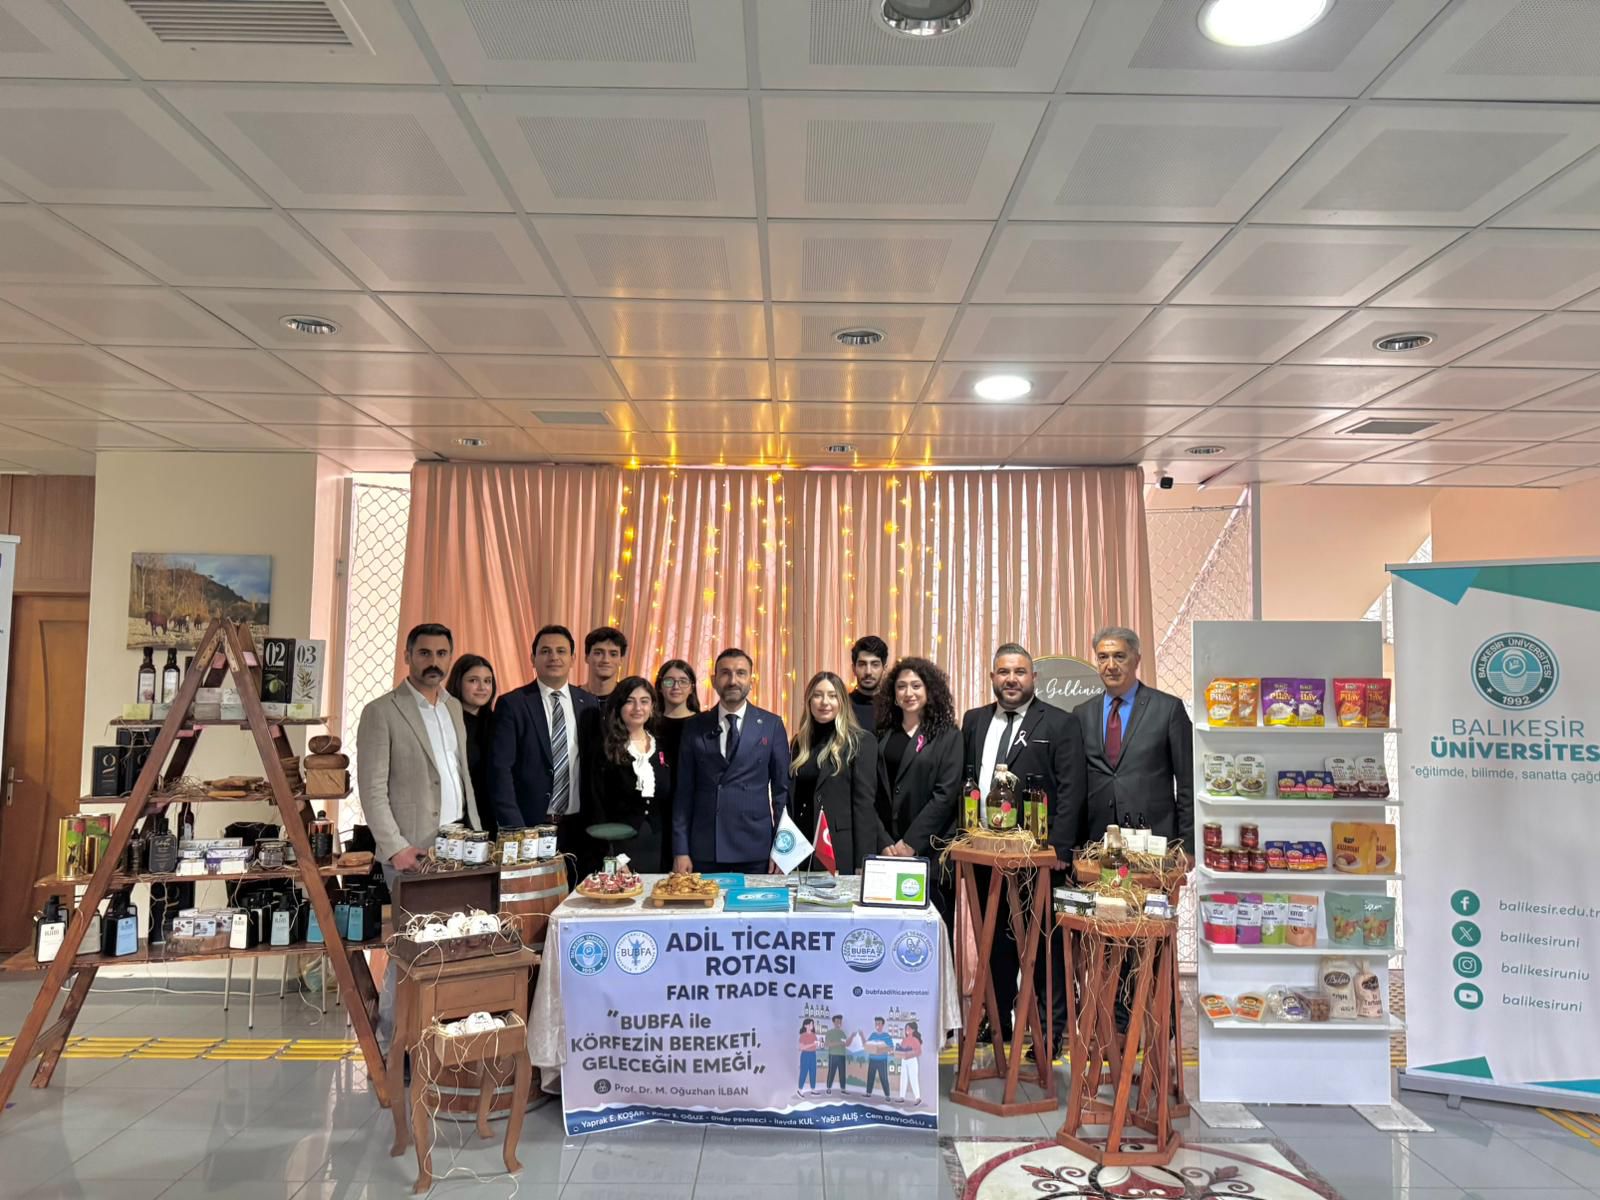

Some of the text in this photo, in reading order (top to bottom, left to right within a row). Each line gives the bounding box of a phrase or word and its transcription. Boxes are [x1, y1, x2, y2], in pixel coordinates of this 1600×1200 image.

[265, 641, 286, 667] 02
[296, 644, 317, 665] 03
[1478, 640, 1505, 678] BALIKESİR
[1502, 695, 1531, 706] 1992
[1451, 715, 1585, 738] BALIKESİR
[1471, 767, 1518, 780] bilimde,
[1522, 769, 1567, 781] sanatta
[665, 926, 724, 952] ADİL
[731, 925, 836, 951] TİCARET
[1499, 931, 1580, 949] balikesiruni
[620, 947, 652, 957] BUBFA
[851, 947, 876, 955] BUBFA
[705, 954, 796, 976] ROTASI
[1500, 961, 1590, 981] balikesiruniu
[666, 981, 834, 1001] FAIR TRADE CAFE
[1502, 993, 1583, 1013] balikesiruni
[689, 1013, 712, 1029] ile
[571, 1028, 761, 1053] KÖRFEZİN BEREKETİ,
[582, 1054, 687, 1074] GELECEĞİN
[614, 1083, 749, 1098] Prof. Dr. M. Oğuzhan İLBAN
[581, 1116, 608, 1129] Yaprak
[609, 1114, 617, 1123] E.
[617, 1109, 645, 1122] KOŞAR
[798, 1117, 814, 1125] KUL
[821, 1114, 840, 1125] Yağız
[842, 1112, 858, 1122] ALIŞ
[865, 1112, 883, 1121] Cem
